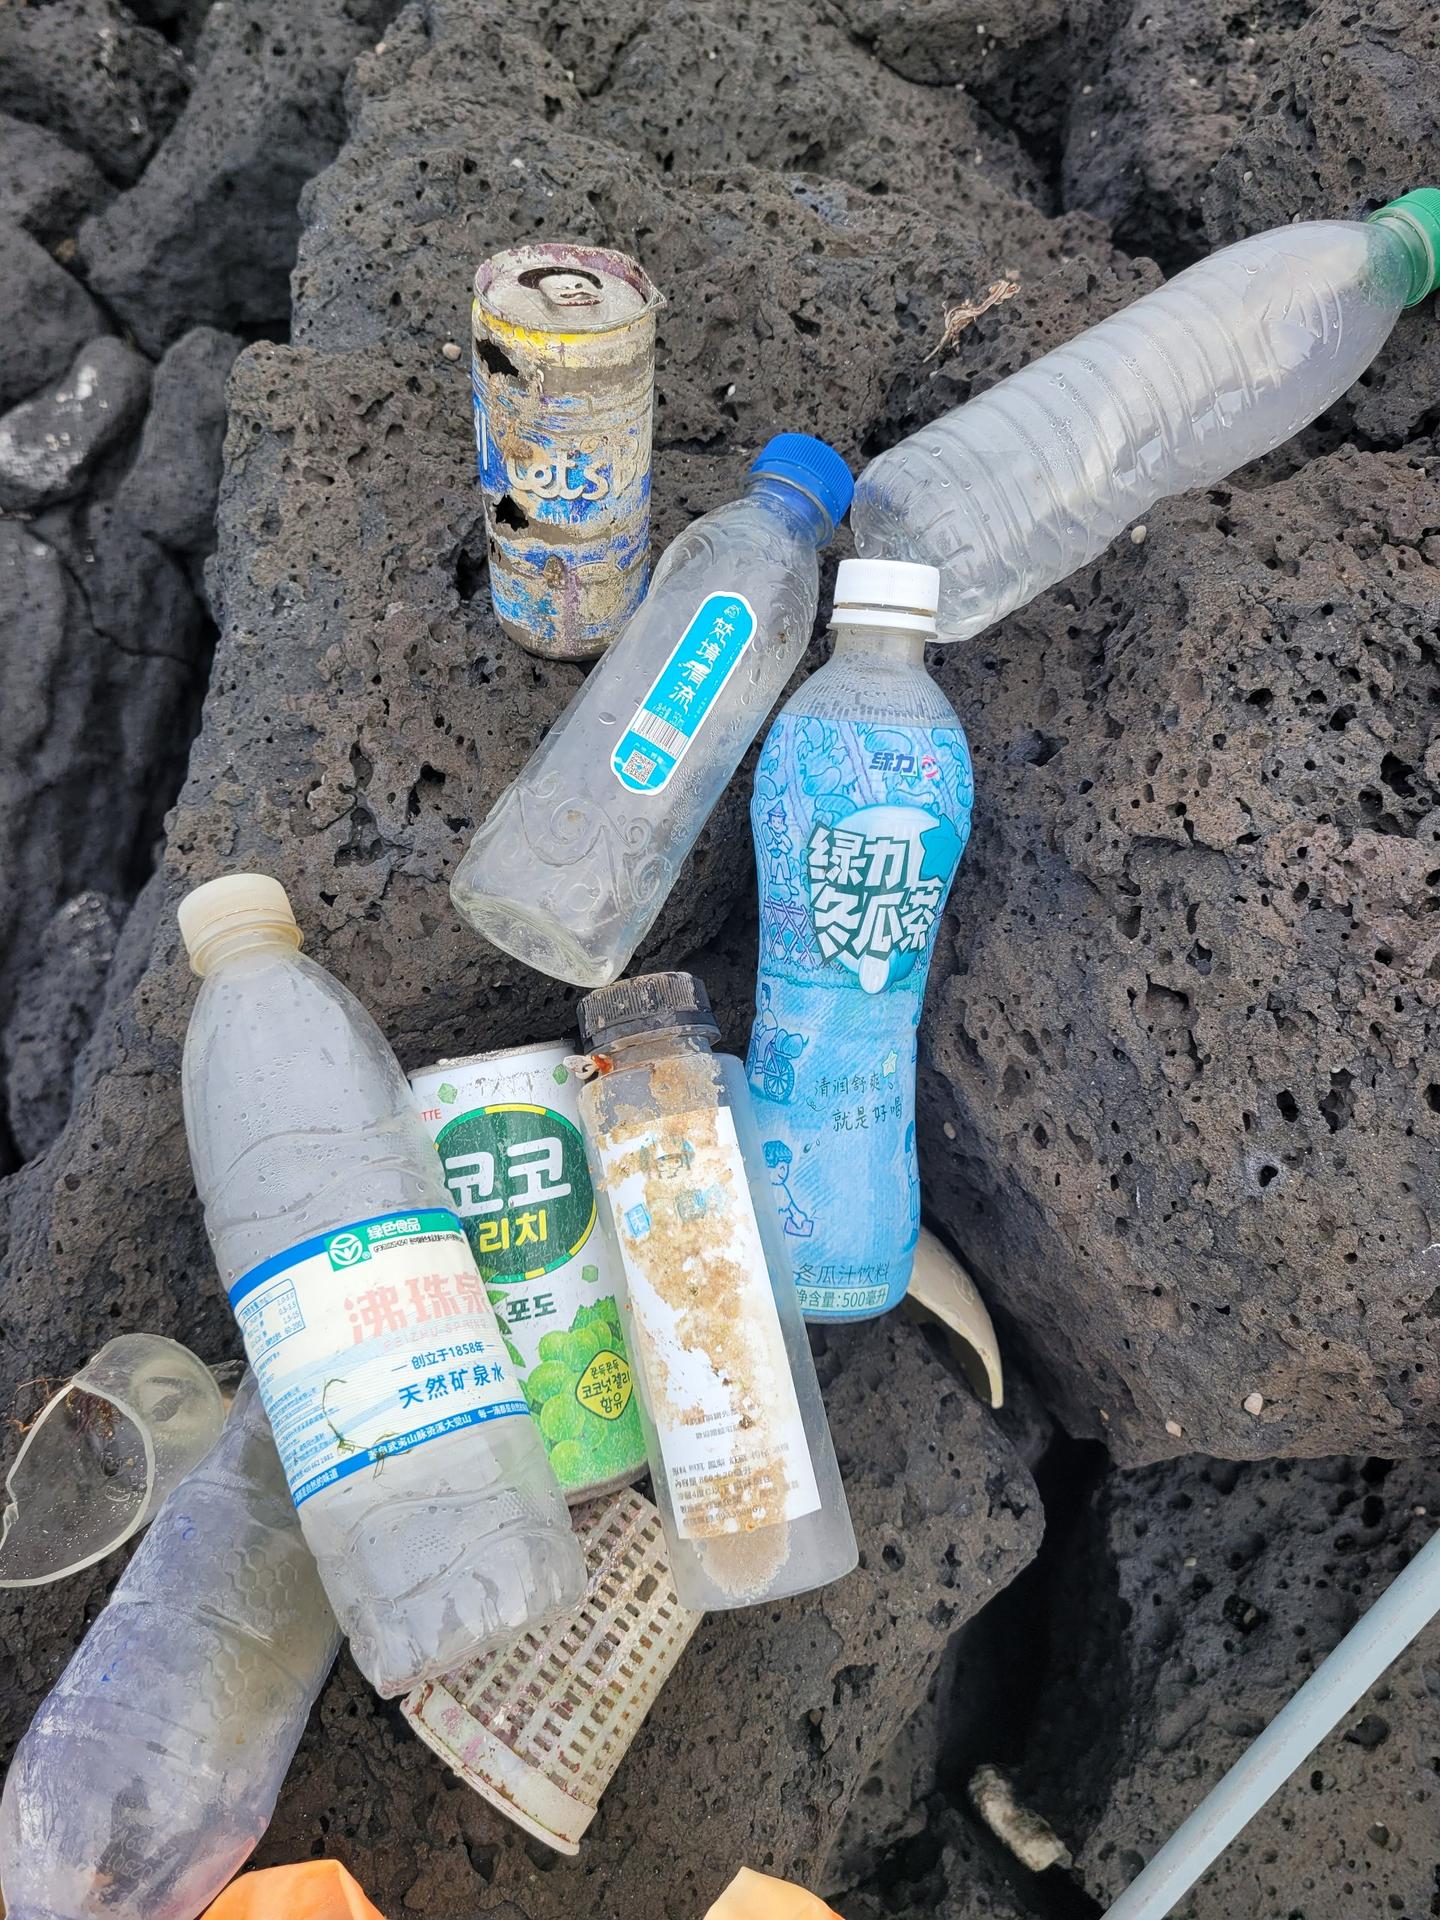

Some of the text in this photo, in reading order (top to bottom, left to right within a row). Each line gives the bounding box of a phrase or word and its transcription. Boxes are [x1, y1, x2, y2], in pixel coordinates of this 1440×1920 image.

[868, 752, 915, 773] 绿力
[809, 828, 911, 888] 绿力
[814, 884, 941, 958] 冬瓜茶
[420, 1108, 442, 1122] TTE
[832, 1096, 903, 1130] 就是好喝
[445, 1136, 572, 1218] 코코
[366, 1217, 421, 1240] 绿色食品
[478, 1214, 548, 1254] 리치
[506, 1292, 558, 1323] 포도
[411, 1341, 485, 1369] 创立于1858年
[590, 1358, 620, 1379] 쫀득쫀득
[398, 1361, 505, 1409] 天然矿泉水
[600, 1392, 623, 1413] 함유
